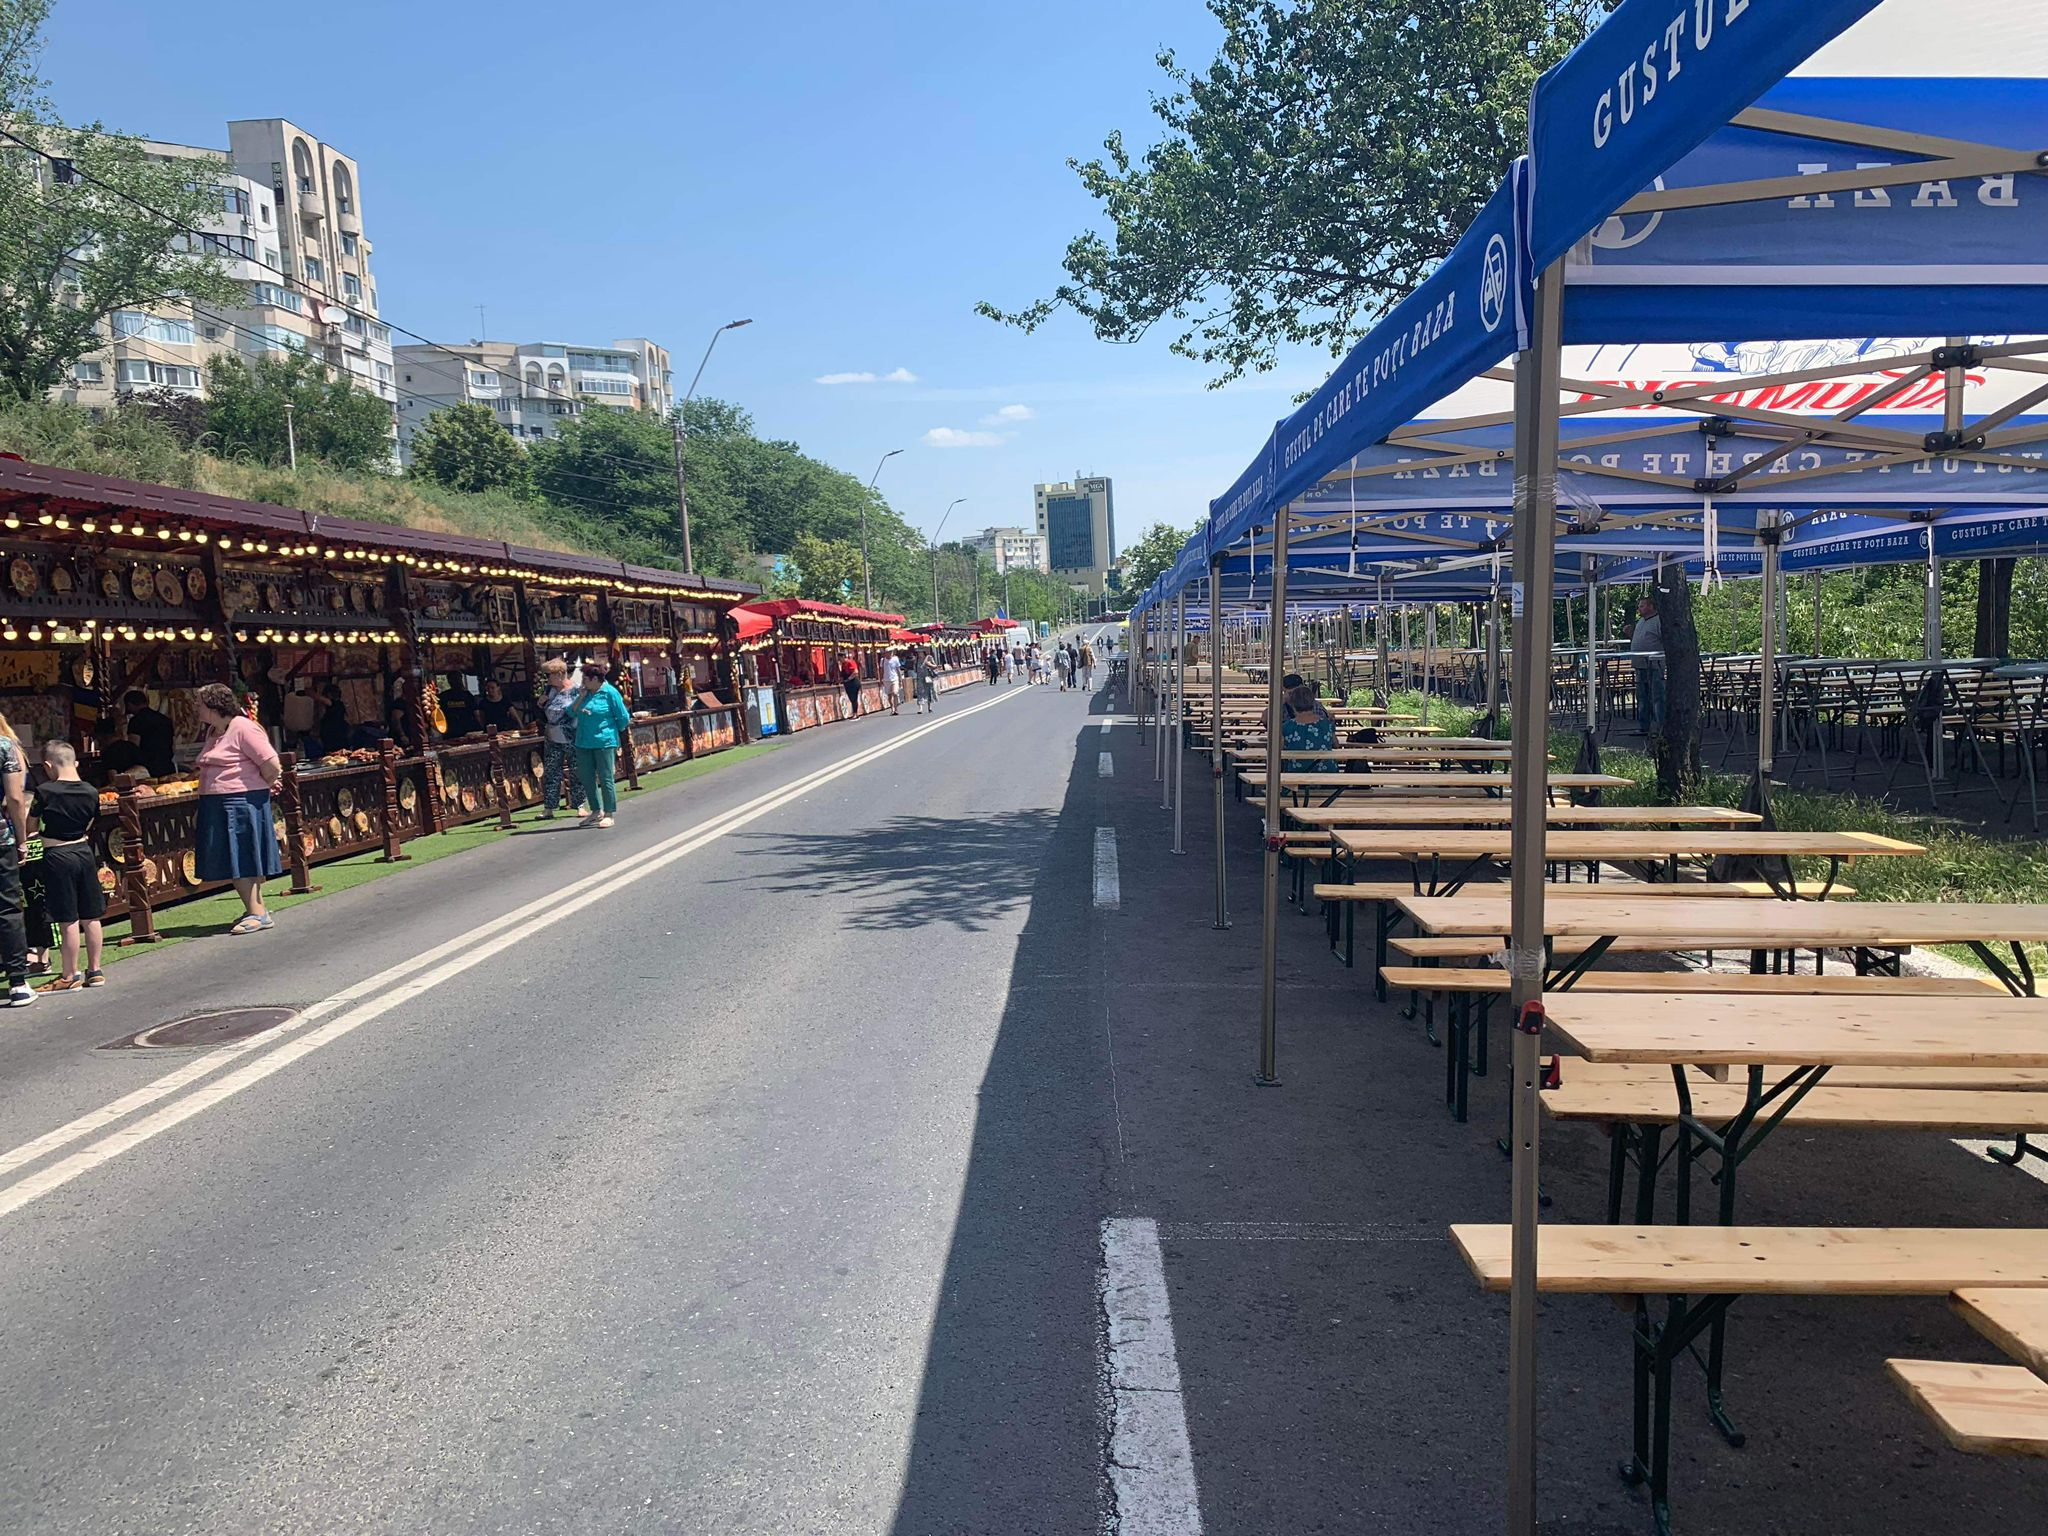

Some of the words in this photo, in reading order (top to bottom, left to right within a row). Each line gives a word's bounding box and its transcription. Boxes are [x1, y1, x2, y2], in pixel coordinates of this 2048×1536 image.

[1326, 381, 1352, 429] CARE
[1355, 365, 1370, 403] TE
[1411, 290, 1456, 358] BAZA
[1951, 525, 1988, 540] GUSTUL
[1992, 523, 2005, 533] PE
[2008, 516, 2038, 531] CARE
[1792, 548, 1818, 558] GUSTUL
[1830, 541, 1850, 552] CARE
[1852, 540, 1862, 549] TE
[1887, 536, 1909, 546] BAZA
